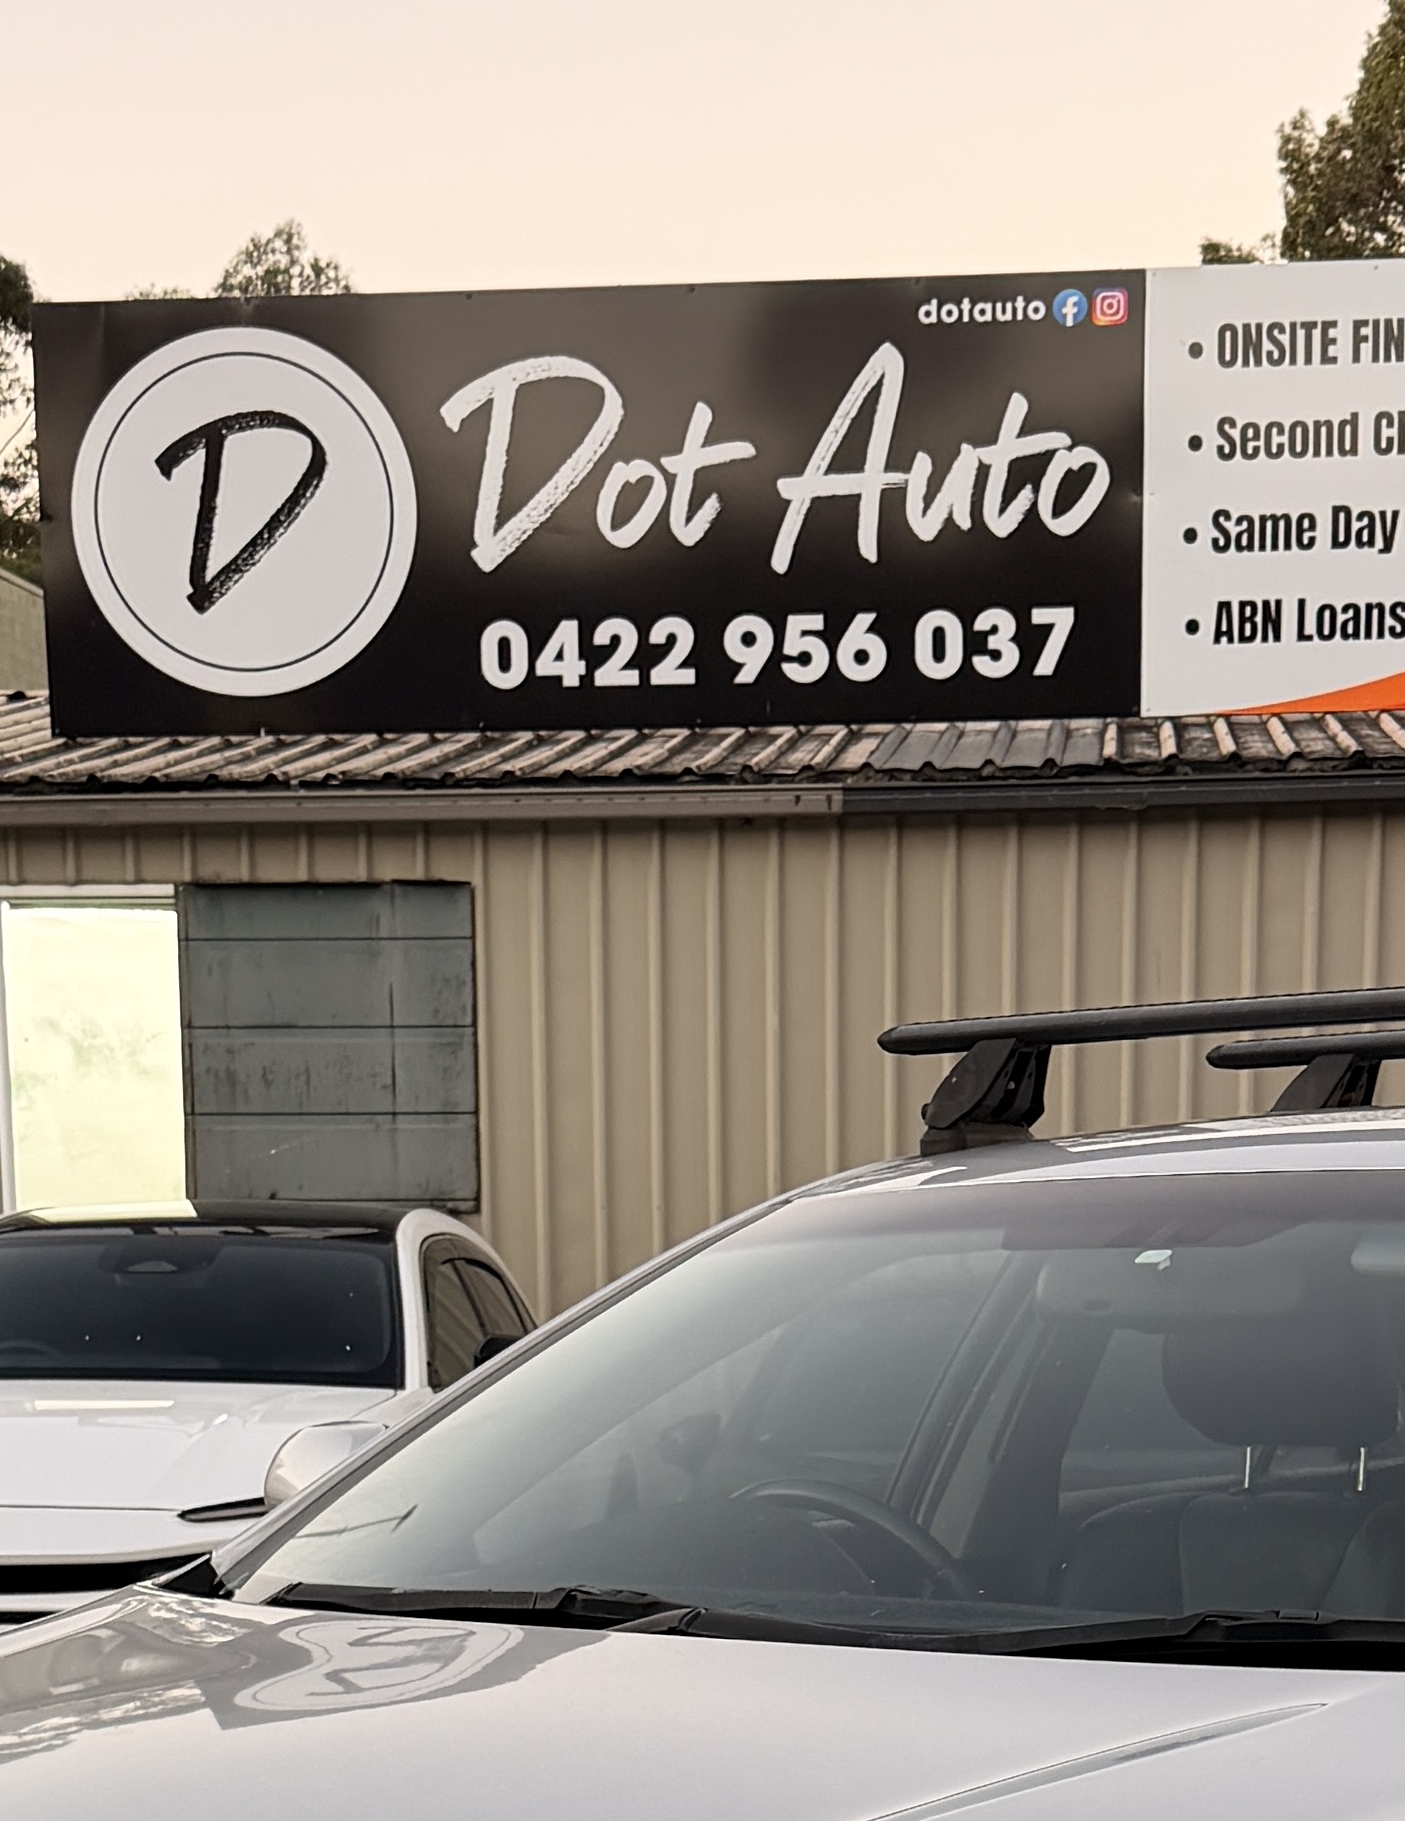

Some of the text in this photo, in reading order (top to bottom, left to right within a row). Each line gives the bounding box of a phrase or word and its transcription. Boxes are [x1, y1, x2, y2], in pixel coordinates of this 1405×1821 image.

[918, 295, 1046, 325] dotauto
[1216, 319, 1338, 369] ONSITE
[439, 341, 1110, 575] Dot Auto
[1215, 412, 1359, 461] Second
[154, 410, 328, 615] D
[1211, 508, 1317, 554] Same
[1330, 504, 1399, 554] Day
[1212, 599, 1283, 645] ABN
[479, 607, 1076, 690] 0422 956 037
